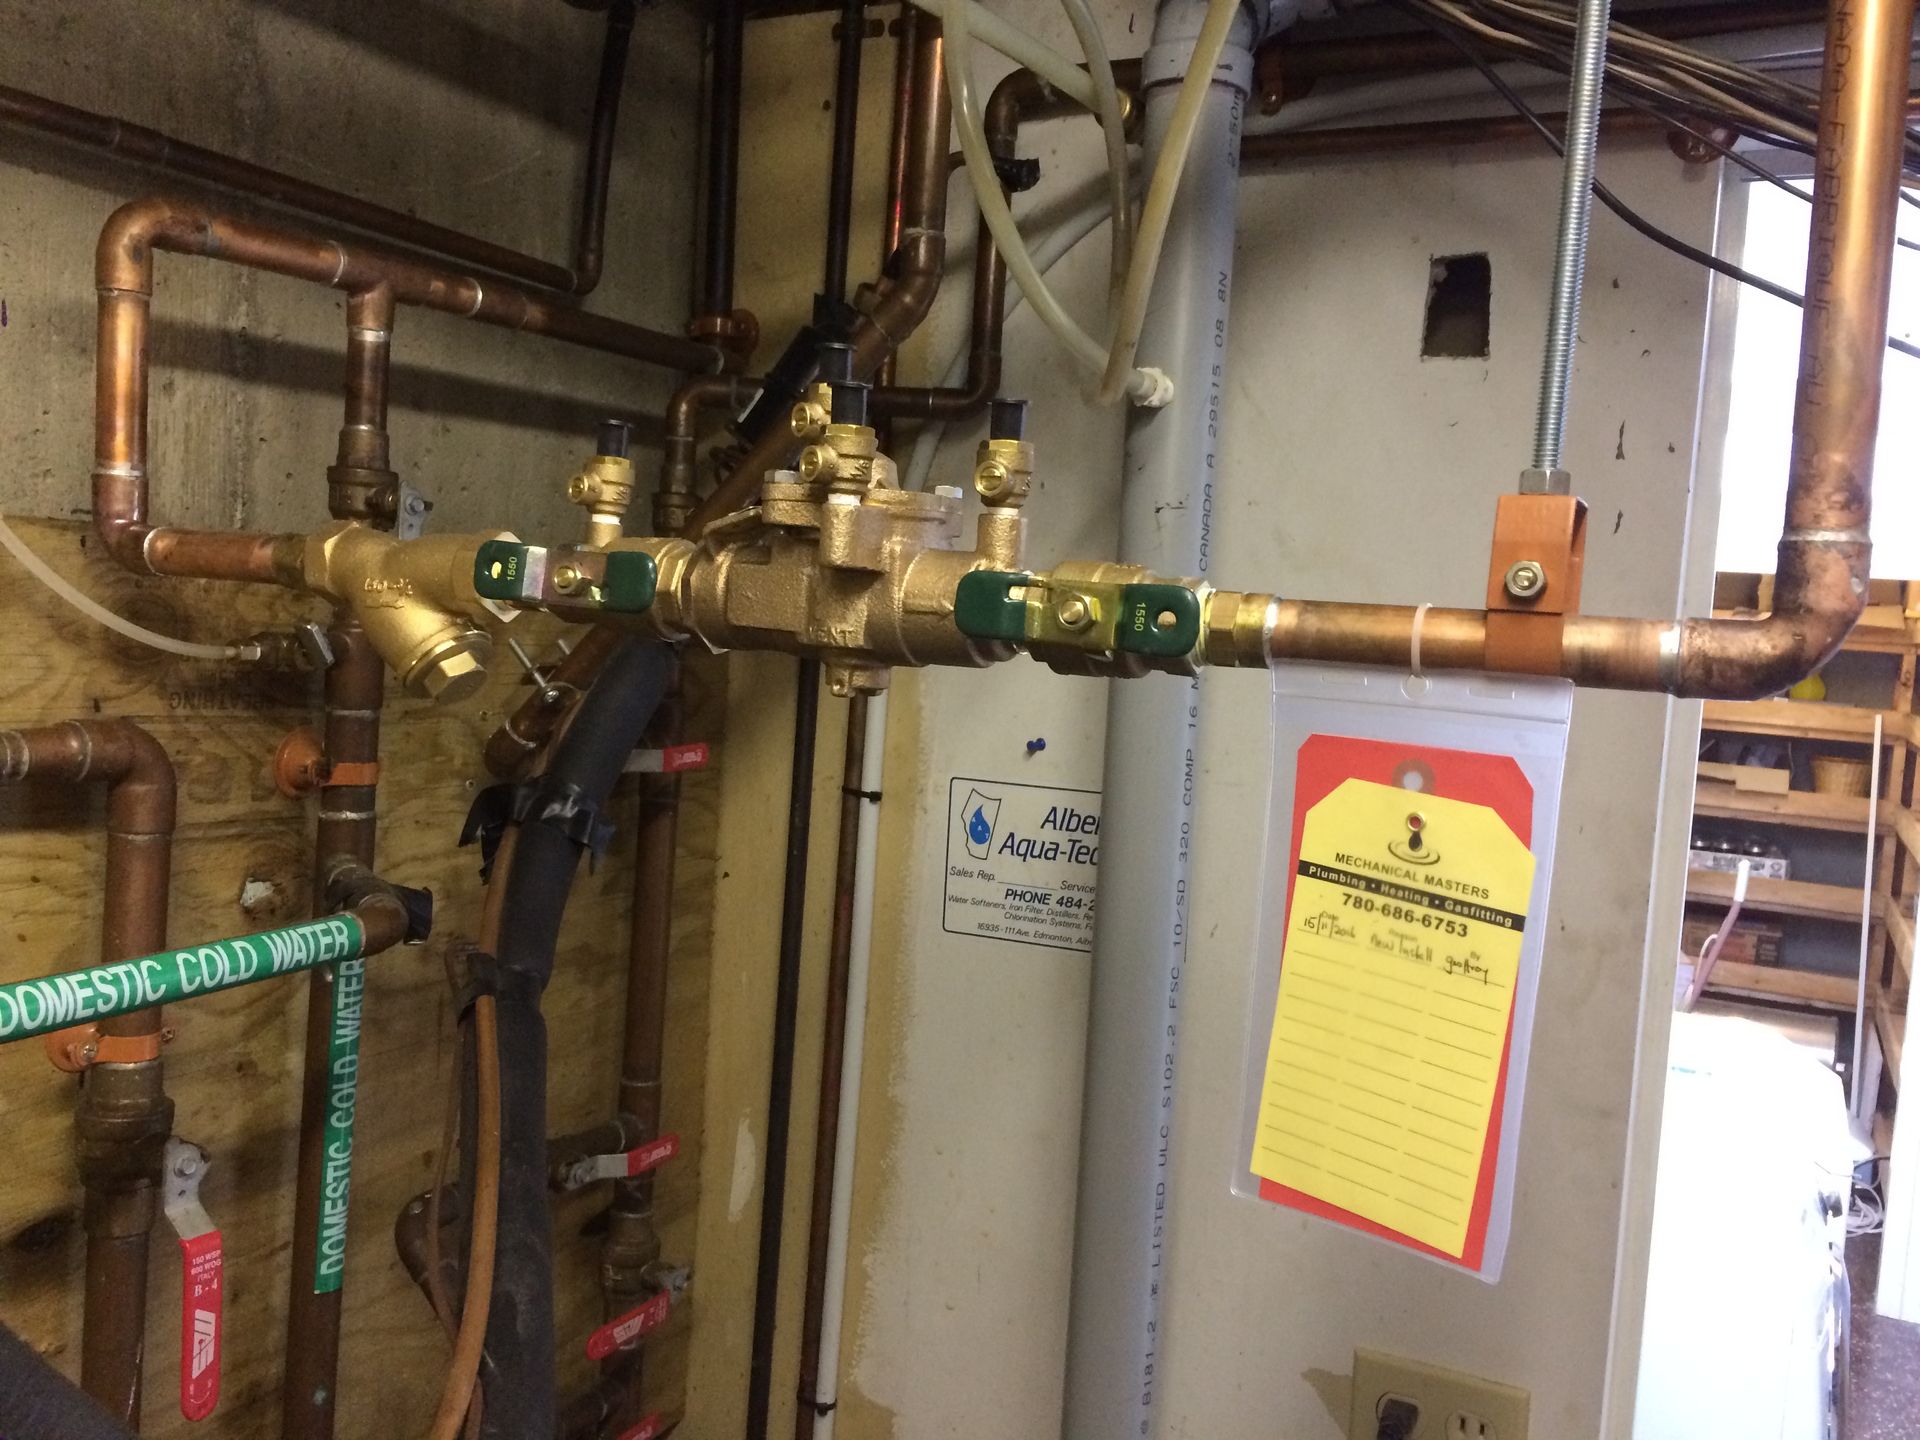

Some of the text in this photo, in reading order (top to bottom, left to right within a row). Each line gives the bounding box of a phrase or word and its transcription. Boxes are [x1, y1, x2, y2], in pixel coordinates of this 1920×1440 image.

[1199, 482, 1213, 572] CANADA
[1208, 365, 1221, 439] 29515
[507, 556, 518, 581] 1550
[1134, 602, 1147, 632] 1550
[1188, 705, 1198, 729] 16
[1183, 748, 1194, 806] COMP
[1179, 822, 1190, 863] 320
[949, 866, 974, 879] Sales
[976, 870, 995, 882] Rep.
[1334, 852, 1490, 900] MECHANICAL MASTERS
[1003, 912, 1047, 924] Chlorination
[1005, 888, 1052, 906] PHONE
[1008, 903, 1023, 912] Iron
[1173, 879, 1185, 948] 10/SD
[1309, 866, 1513, 928] Plumbing Heating Gasfitting
[1342, 892, 1468, 938] 780-686-6753
[0, 920, 349, 1037] DOMESTIC COLD WATER
[1169, 966, 1180, 1009] FSC
[320, 958, 365, 1276] DOMESTIC COLD WATER
[1158, 1125, 1169, 1167] ULC
[1152, 1182, 1165, 1268] LISTED
